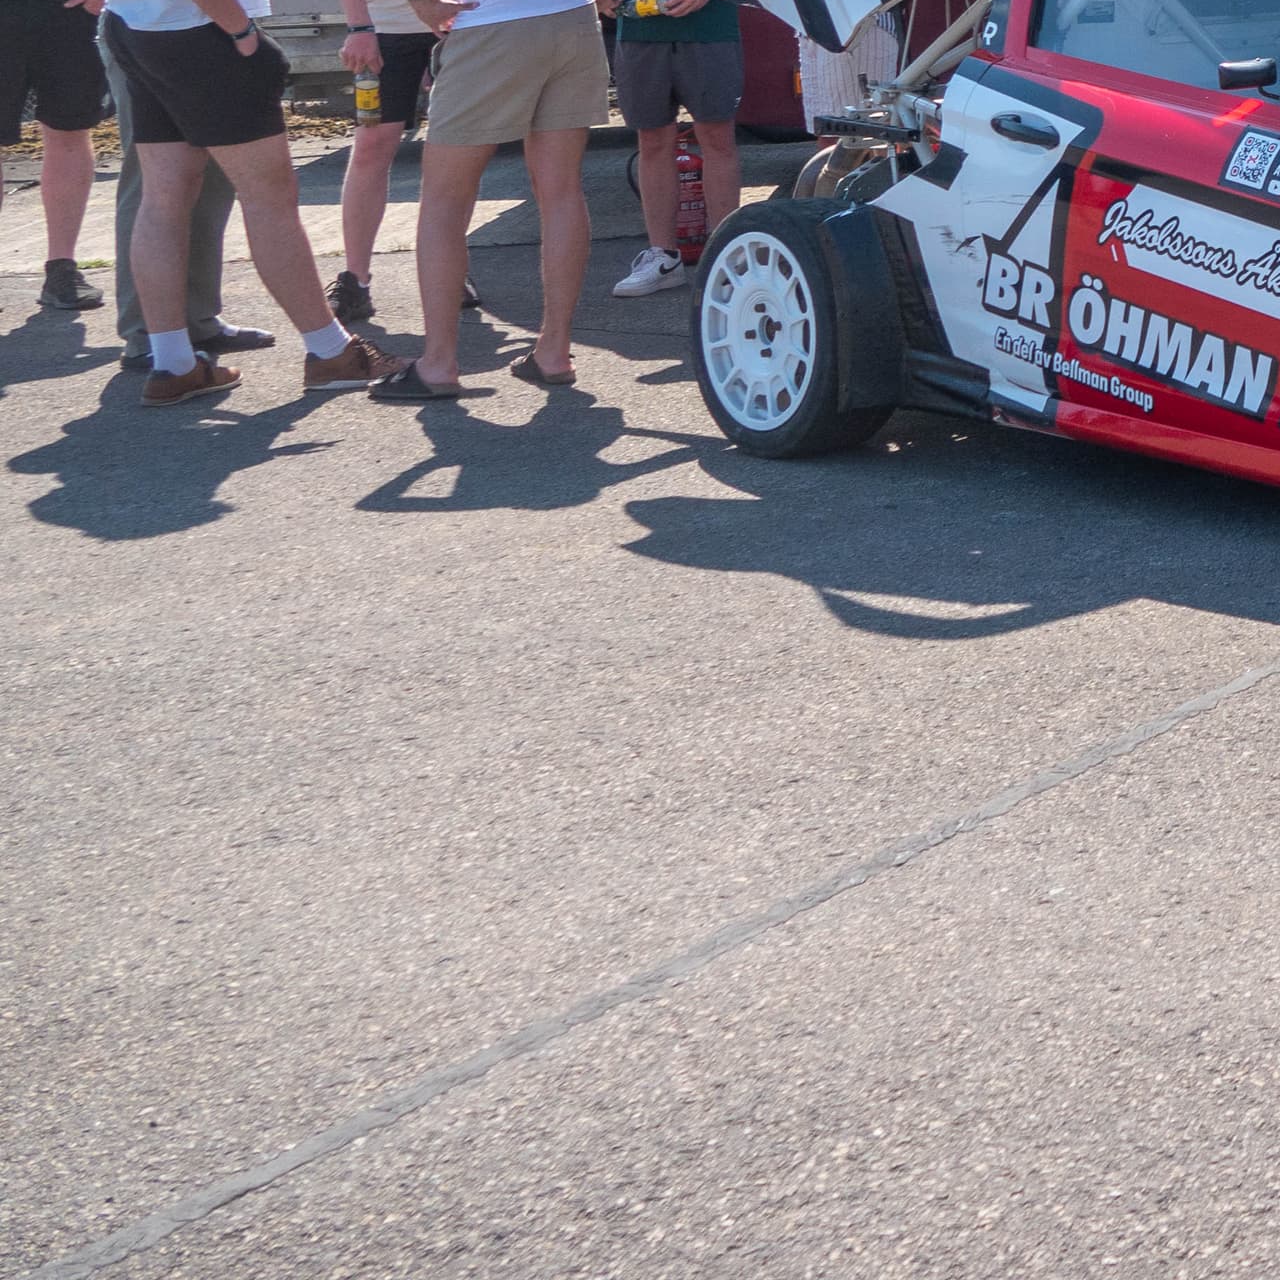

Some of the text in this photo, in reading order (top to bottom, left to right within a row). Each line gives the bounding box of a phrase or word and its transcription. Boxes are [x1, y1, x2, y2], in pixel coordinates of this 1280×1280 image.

[1098, 200, 1238, 278] Jakobssons
[983, 253, 1056, 329] BR
[1067, 274, 1274, 415] ÖHMAN
[994, 326, 1154, 412] En del av Bellman Group
